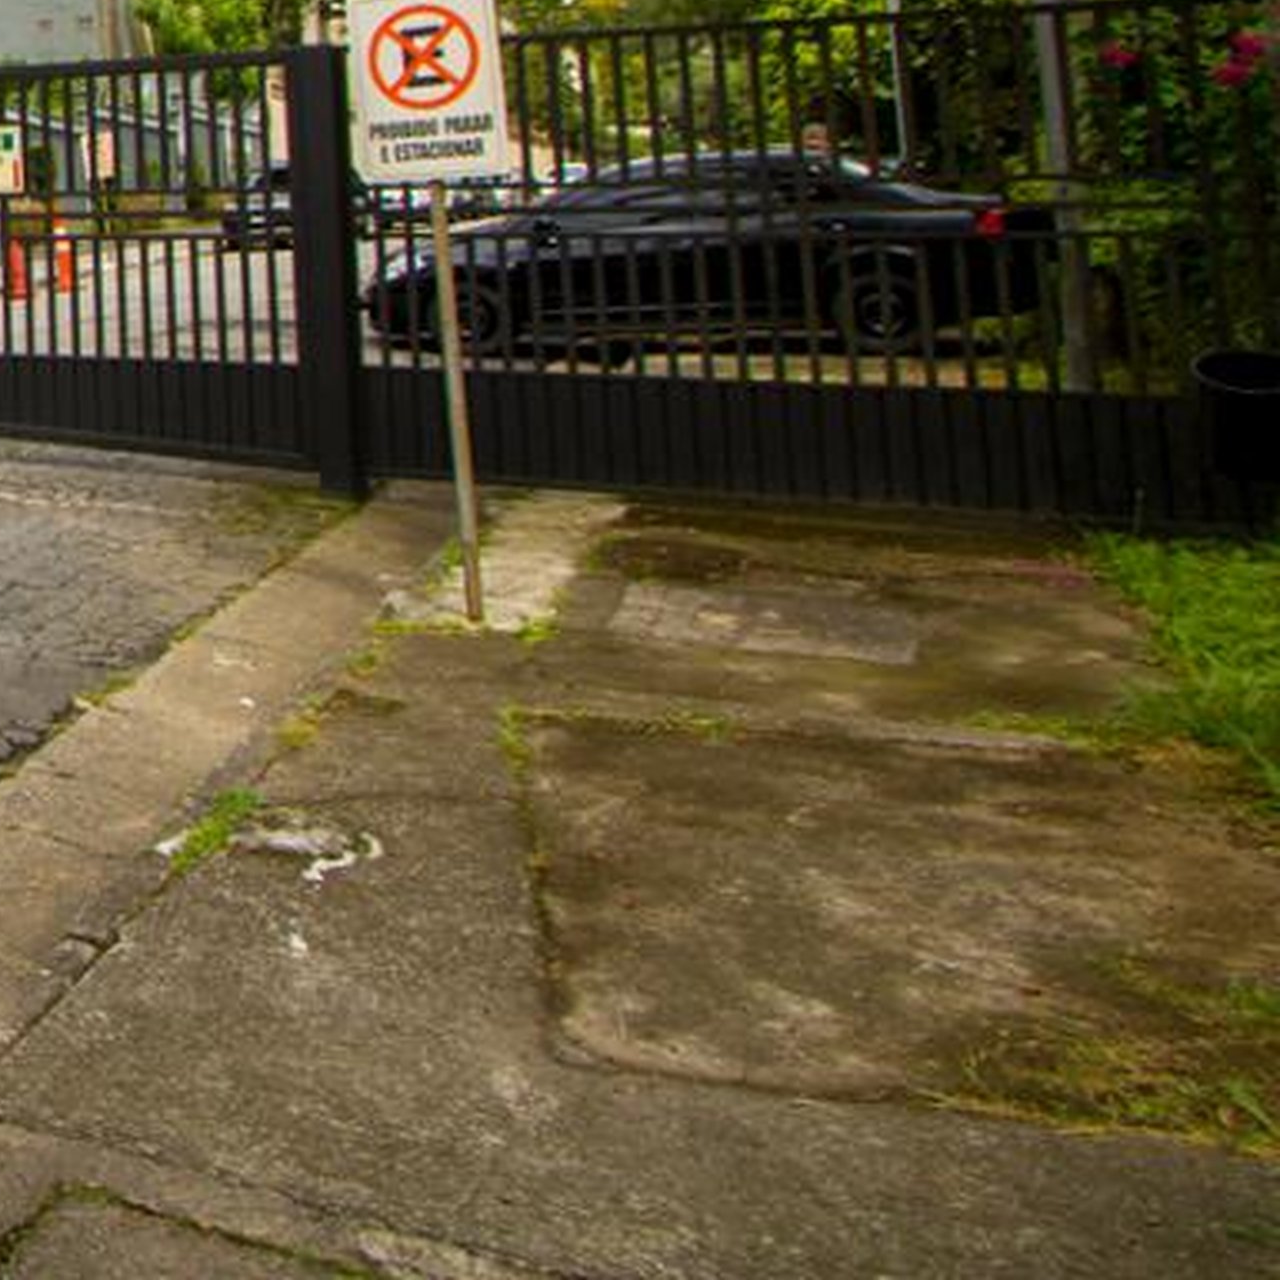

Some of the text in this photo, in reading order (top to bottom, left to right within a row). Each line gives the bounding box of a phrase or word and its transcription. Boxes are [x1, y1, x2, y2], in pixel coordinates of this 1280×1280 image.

[369, 113, 493, 140] PROIBIDO PARAR
[381, 137, 484, 163] E ESTACIONAR
